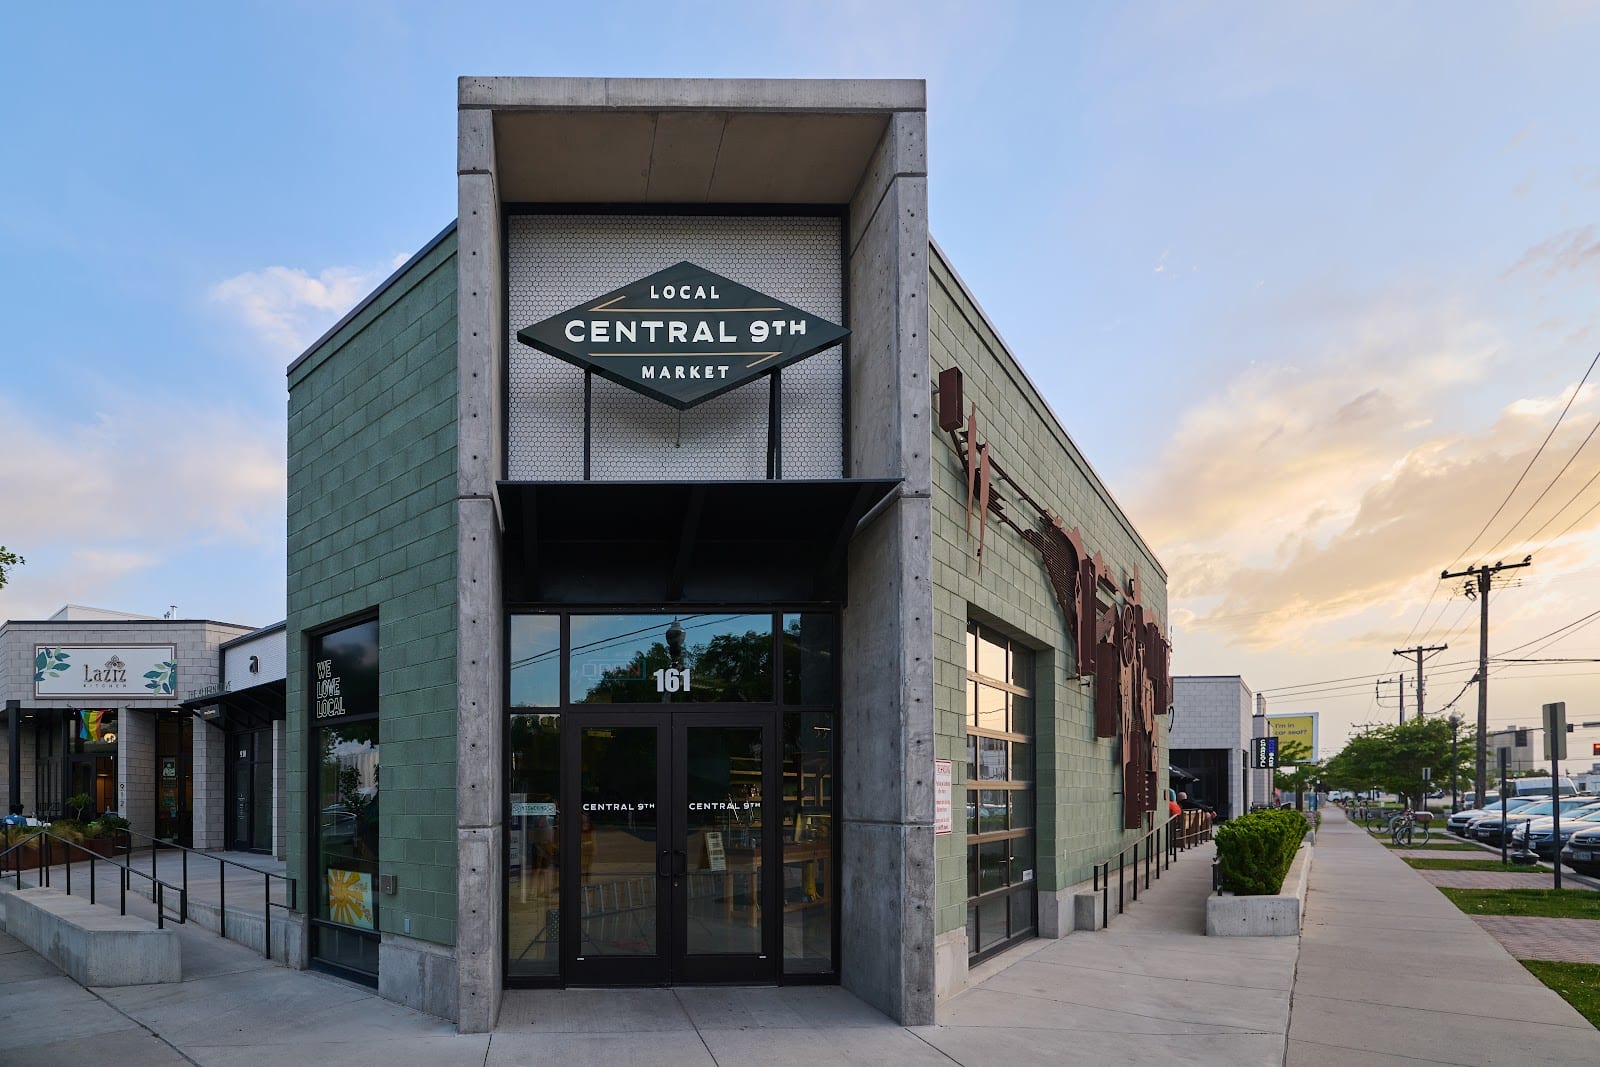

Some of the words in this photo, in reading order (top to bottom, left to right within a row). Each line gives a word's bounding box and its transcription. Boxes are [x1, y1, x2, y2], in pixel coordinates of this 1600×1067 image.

[649, 285, 720, 299] LOCAL
[564, 320, 738, 343] CENTRAL
[748, 319, 807, 343] 9TH
[641, 365, 730, 379] MARKET
[316, 659, 332, 680] WE
[653, 668, 691, 692] 161
[316, 677, 341, 699] LOVE
[316, 697, 346, 719] LOCAL
[582, 803, 635, 811] CENTRAL
[637, 803, 655, 811] 9TH
[688, 802, 741, 810] CENTRAL
[743, 802, 761, 810] 9TH
